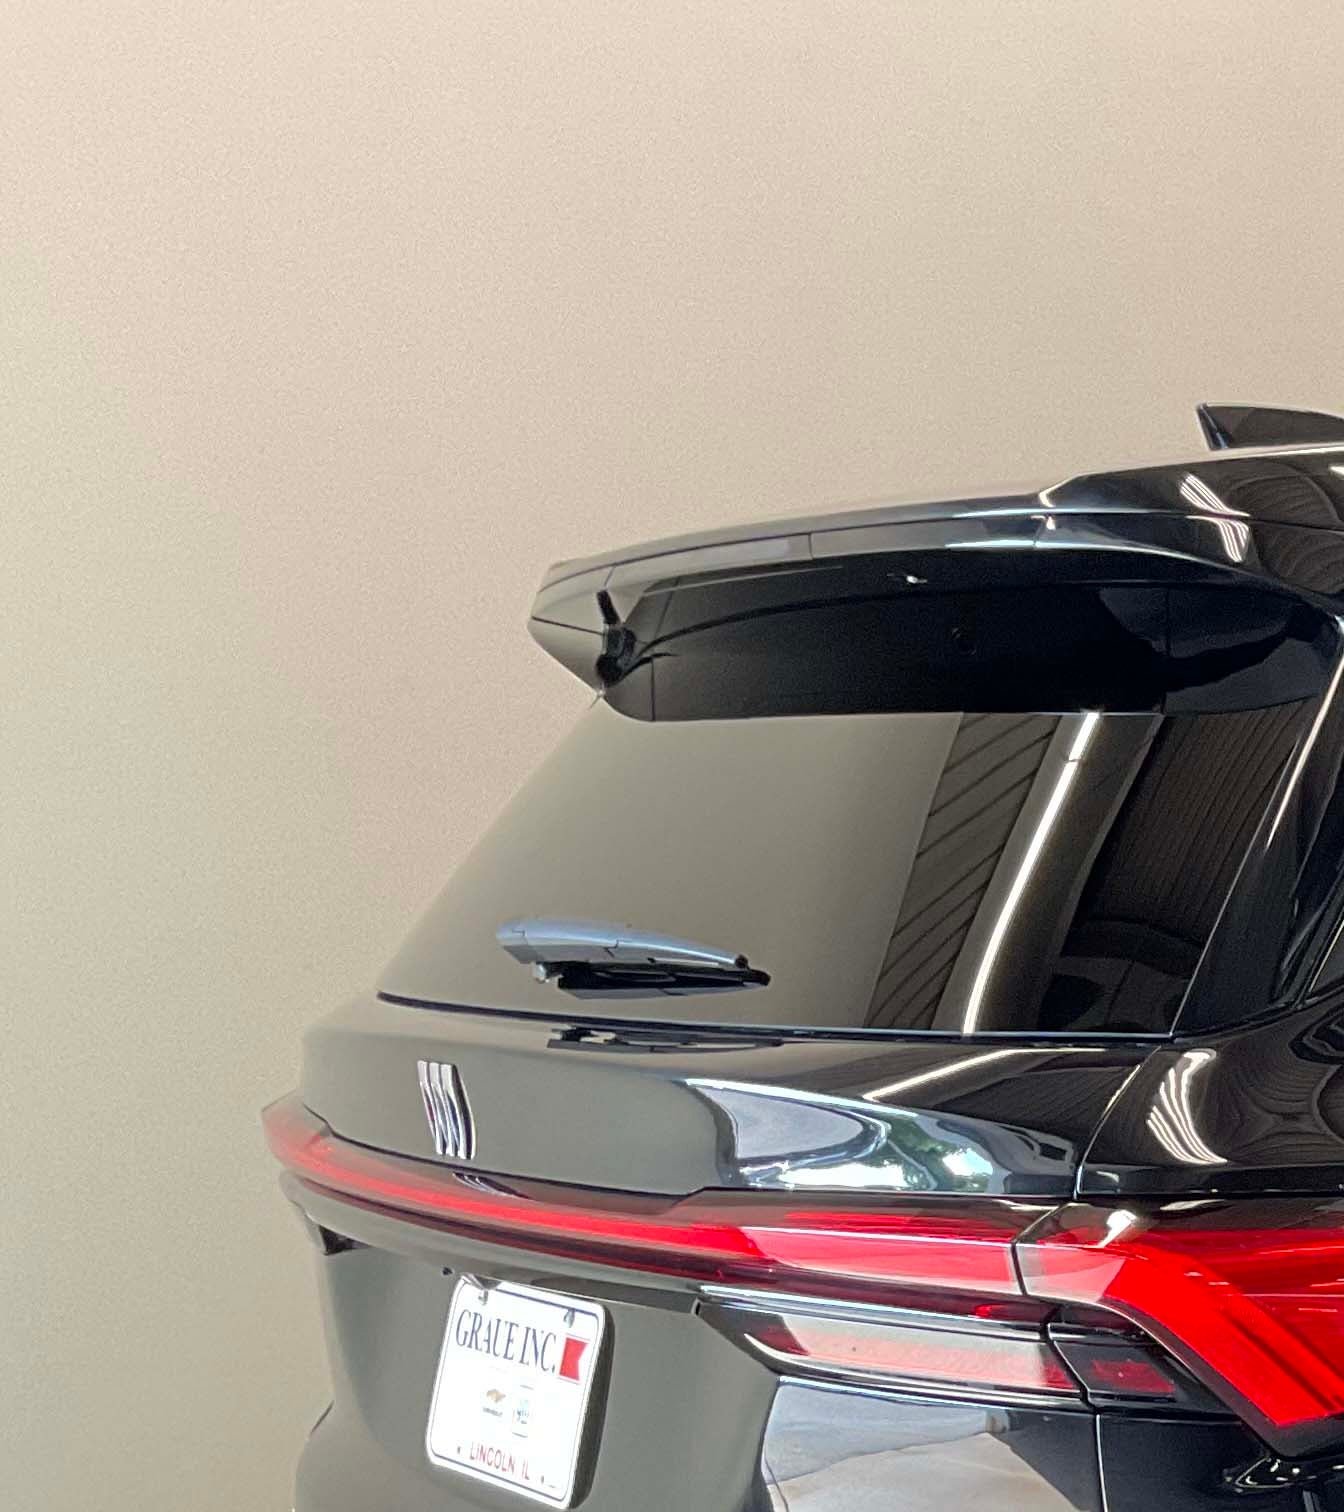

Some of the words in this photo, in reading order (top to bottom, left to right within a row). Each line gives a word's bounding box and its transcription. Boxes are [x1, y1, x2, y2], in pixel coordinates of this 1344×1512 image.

[455, 1309, 519, 1362] GRAUE
[518, 1325, 557, 1374] INC.
[470, 1441, 516, 1476] LINCOLN
[521, 1458, 531, 1481] IL
